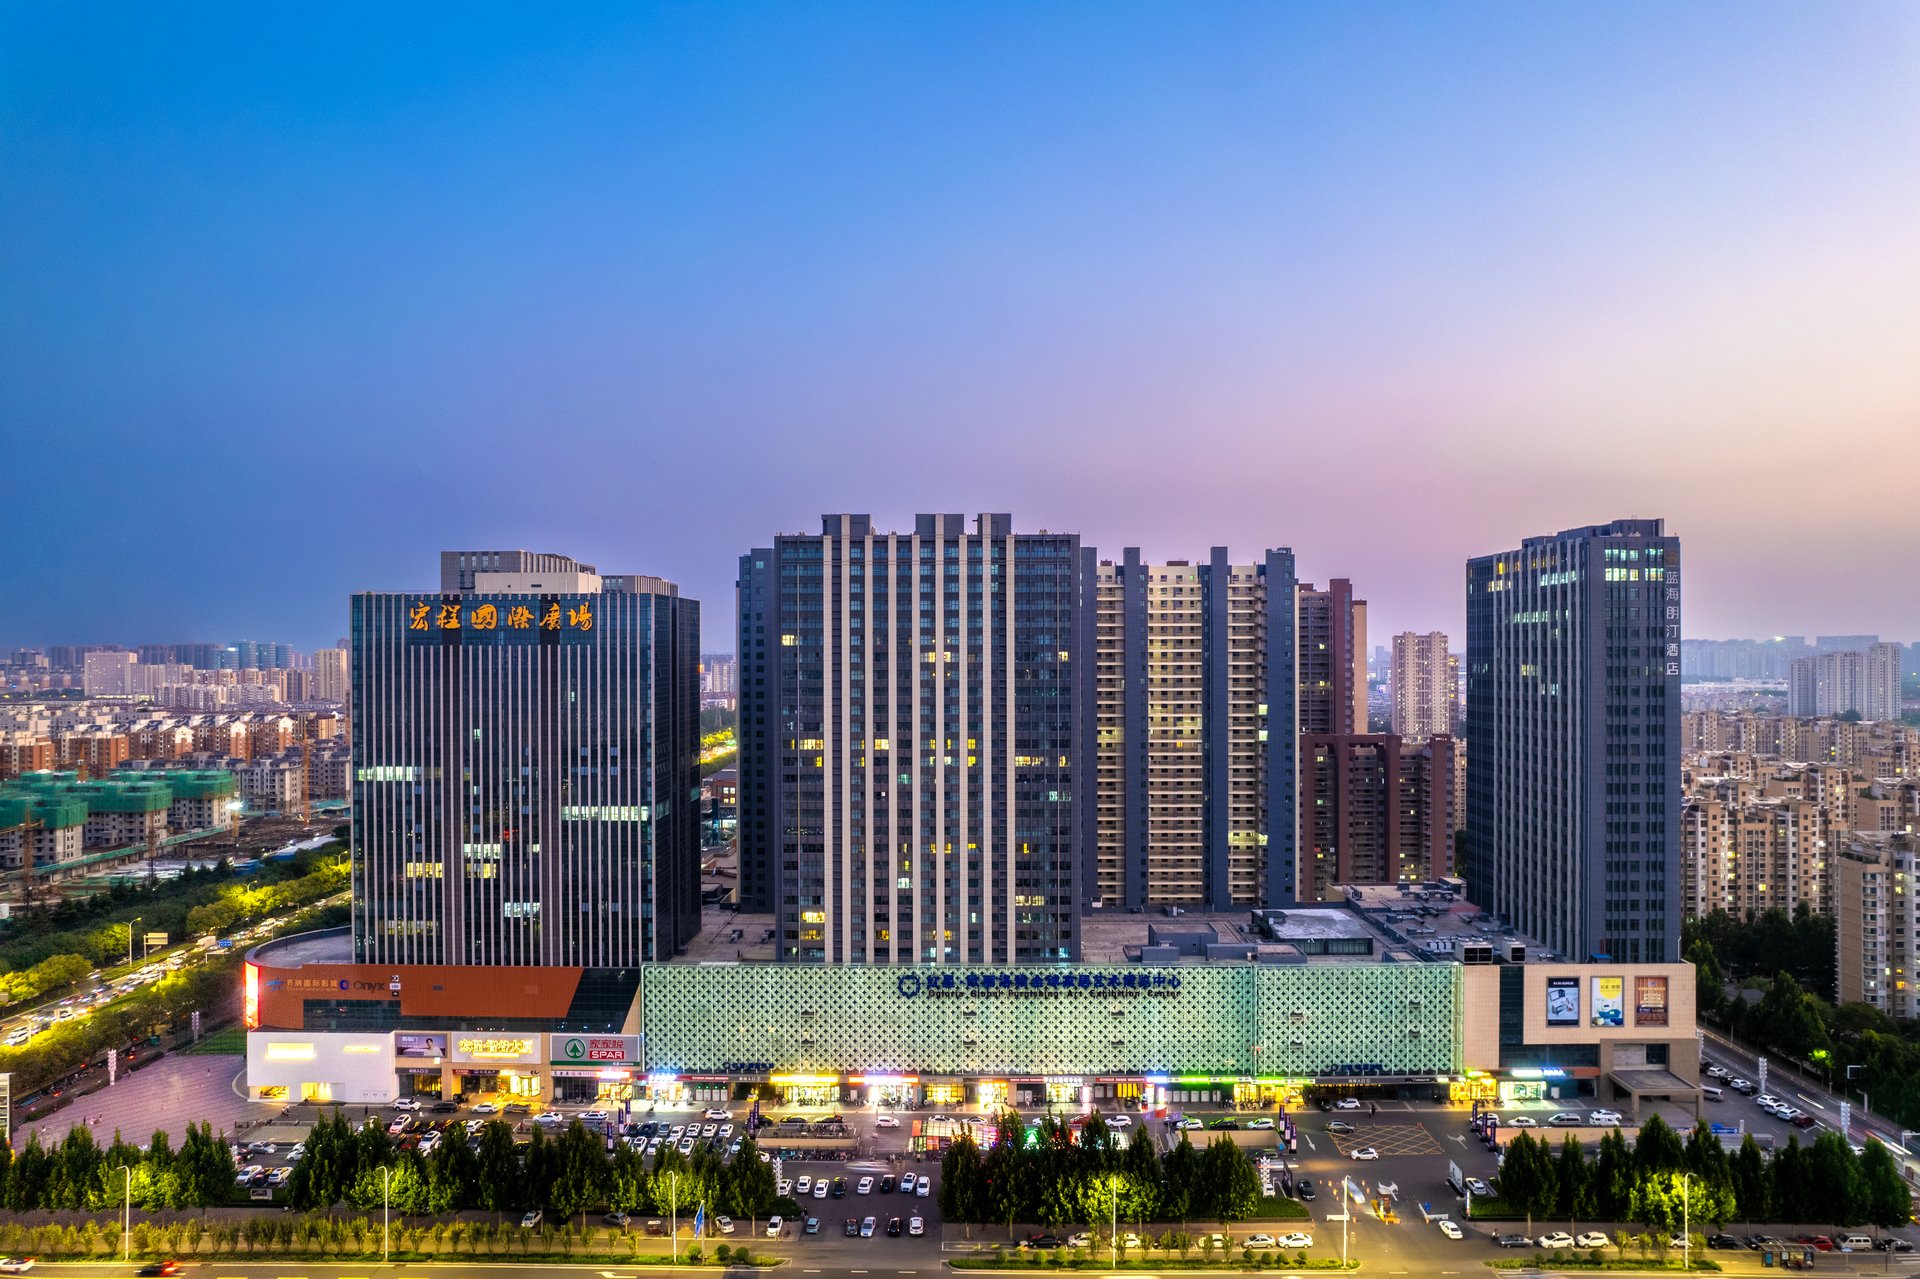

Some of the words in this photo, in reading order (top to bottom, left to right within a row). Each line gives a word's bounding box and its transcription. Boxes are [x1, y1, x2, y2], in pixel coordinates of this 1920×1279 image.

[409, 601, 593, 631] 宏程國際廣場
[1666, 571, 1679, 676] 蓝海朗汀酒店
[353, 980, 385, 993] Onyx
[1067, 989, 1083, 998] Art
[589, 1039, 624, 1049] 家家悦
[591, 1051, 623, 1059] SPAR
